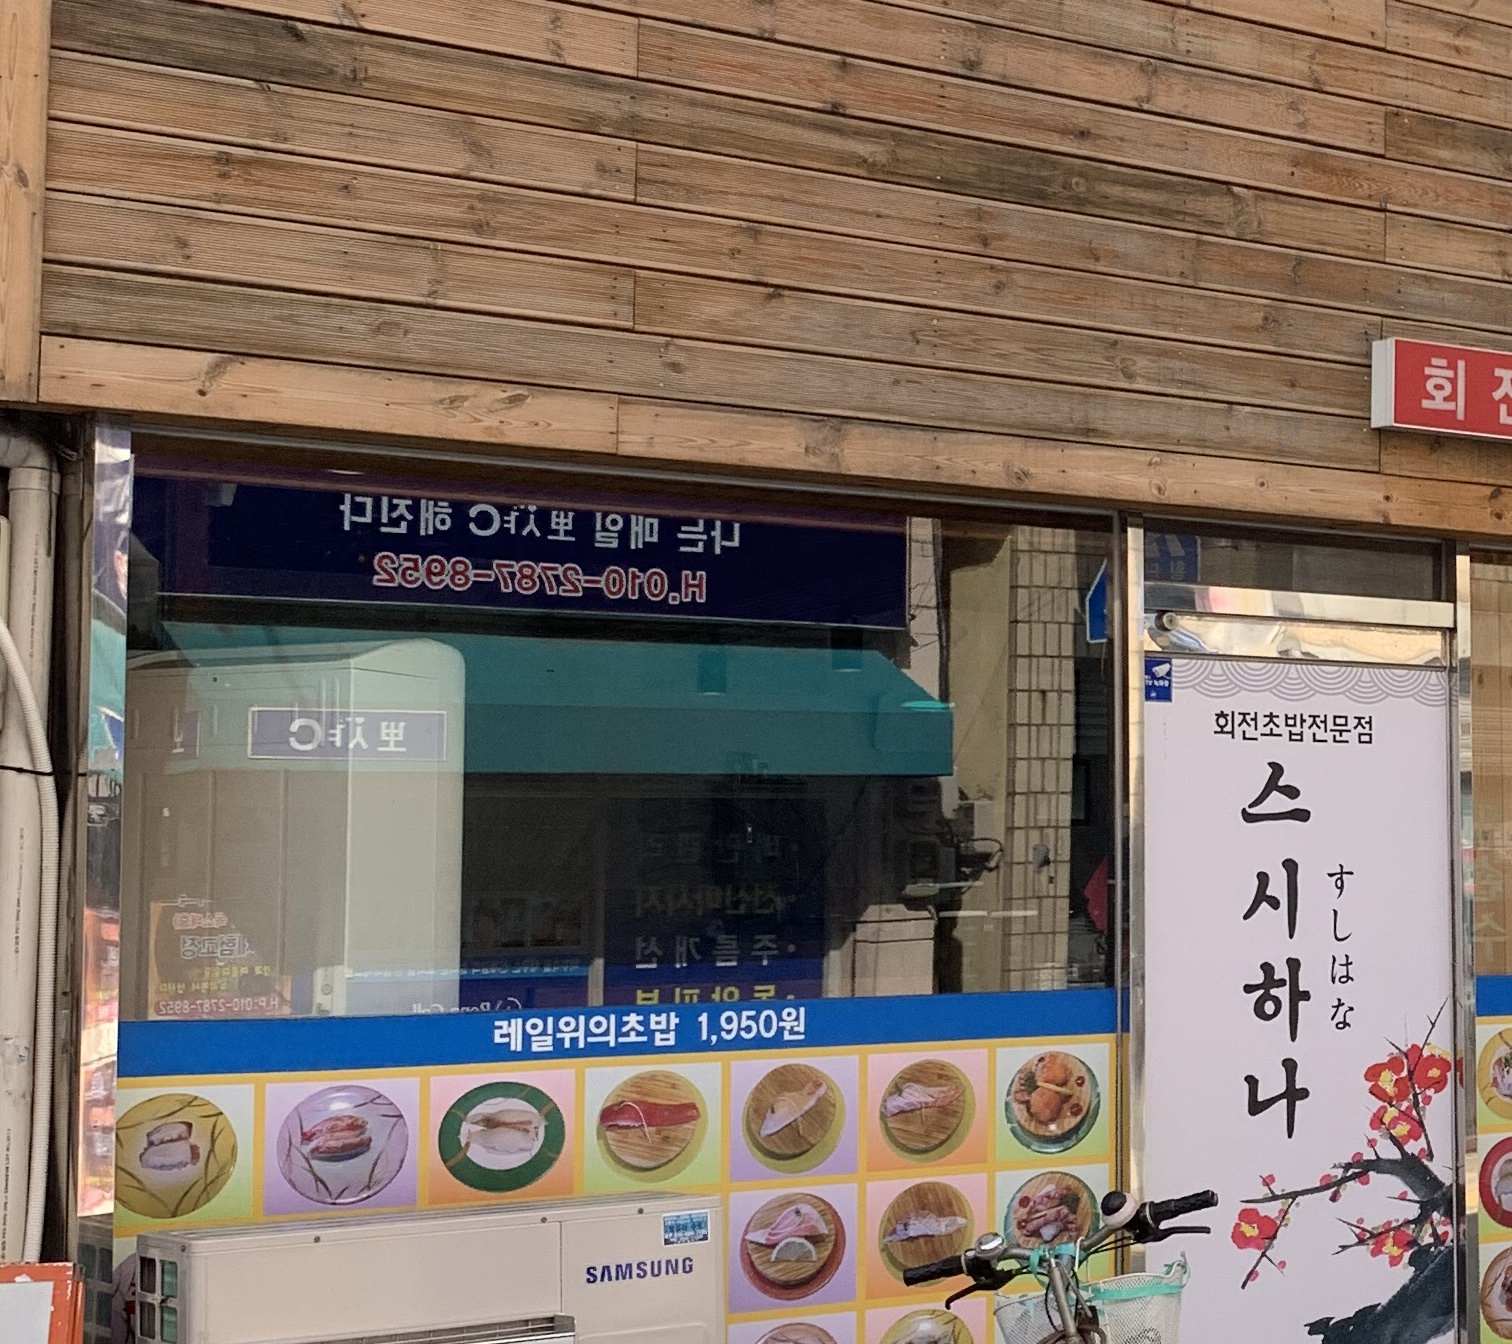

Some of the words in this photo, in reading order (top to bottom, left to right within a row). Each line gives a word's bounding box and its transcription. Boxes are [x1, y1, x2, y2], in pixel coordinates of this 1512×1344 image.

[1213, 710, 1374, 745] 회전초밥전문점
[1240, 760, 1312, 1140] 스시하나
[1326, 863, 1355, 1031] すしはな
[493, 1013, 680, 1053] 레일위의초밥
[696, 1006, 807, 1046] 1,950원
[585, 1255, 695, 1287] SAMSUNG
